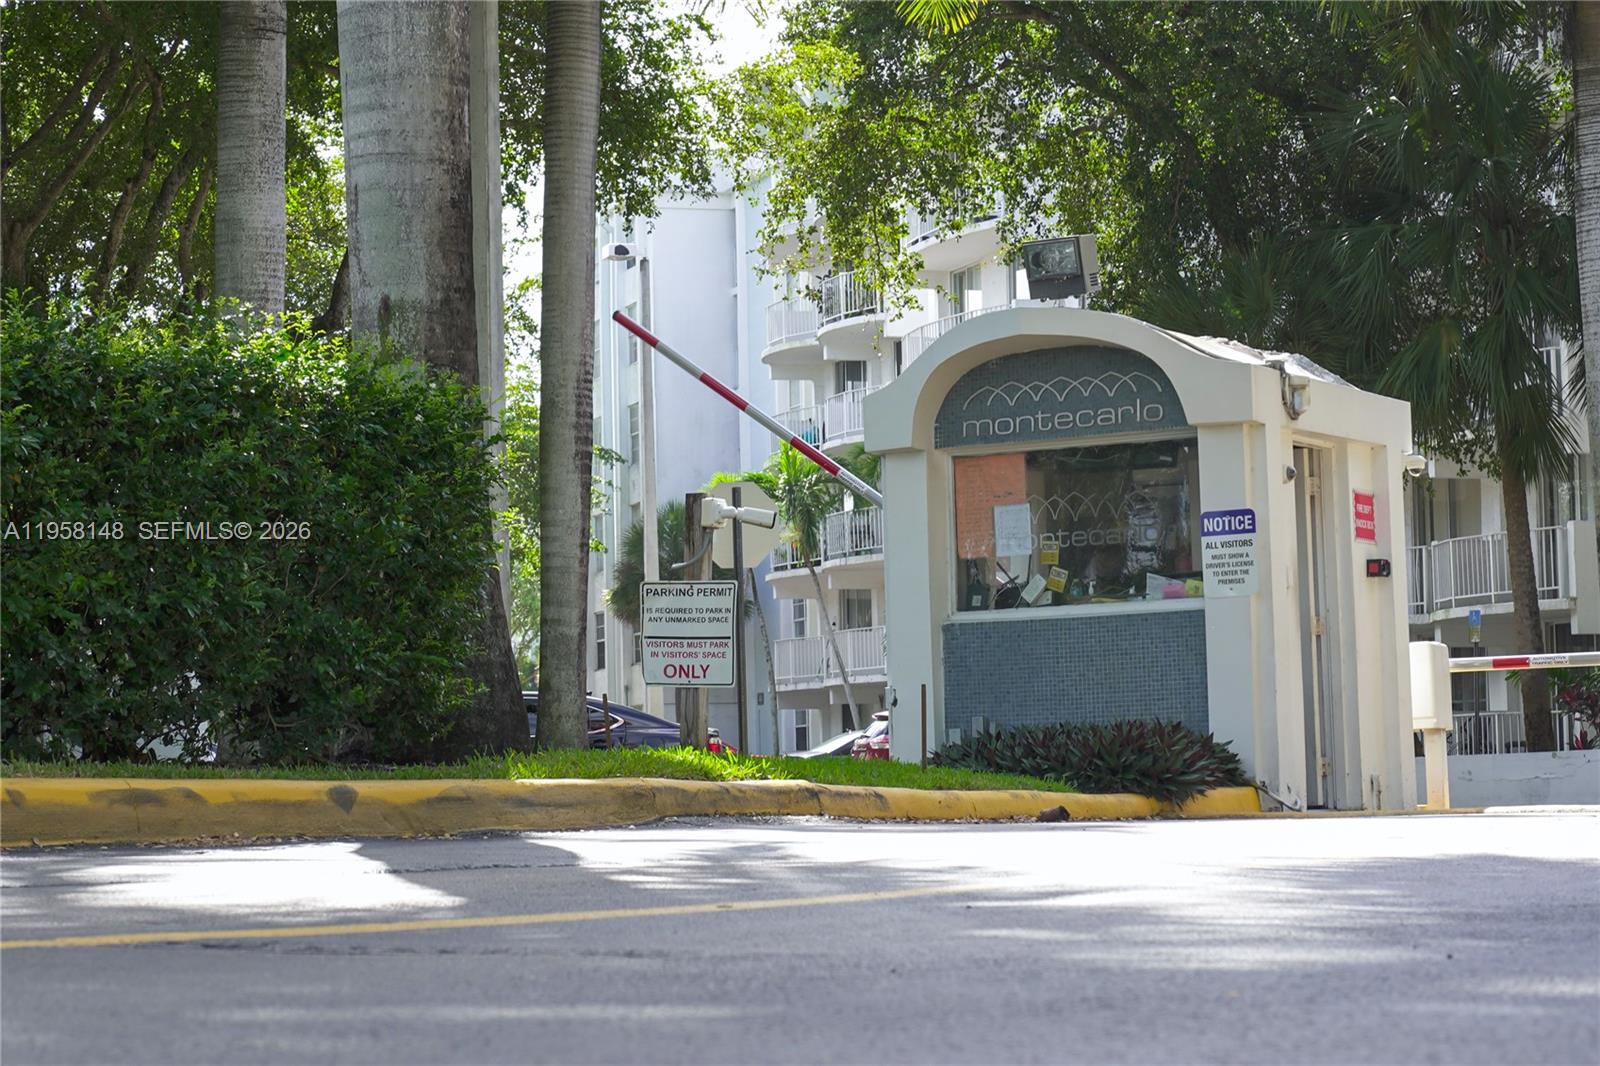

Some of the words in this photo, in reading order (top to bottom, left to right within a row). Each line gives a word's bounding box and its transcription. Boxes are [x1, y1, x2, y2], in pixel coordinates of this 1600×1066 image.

[962, 398, 1164, 437] montecarlo
[1204, 515, 1253, 532] NOTICE
[1205, 541, 1219, 550] ALL
[1220, 539, 1253, 548] VISITORS
[1228, 552, 1244, 560] SHOW
[1205, 562, 1231, 570] DRIVER'S
[1232, 560, 1254, 568] LICENSE
[1218, 578, 1246, 586] PREMISES
[646, 588, 694, 597] PARKING
[696, 587, 733, 597] PERMIT
[663, 664, 710, 679] ONLY
